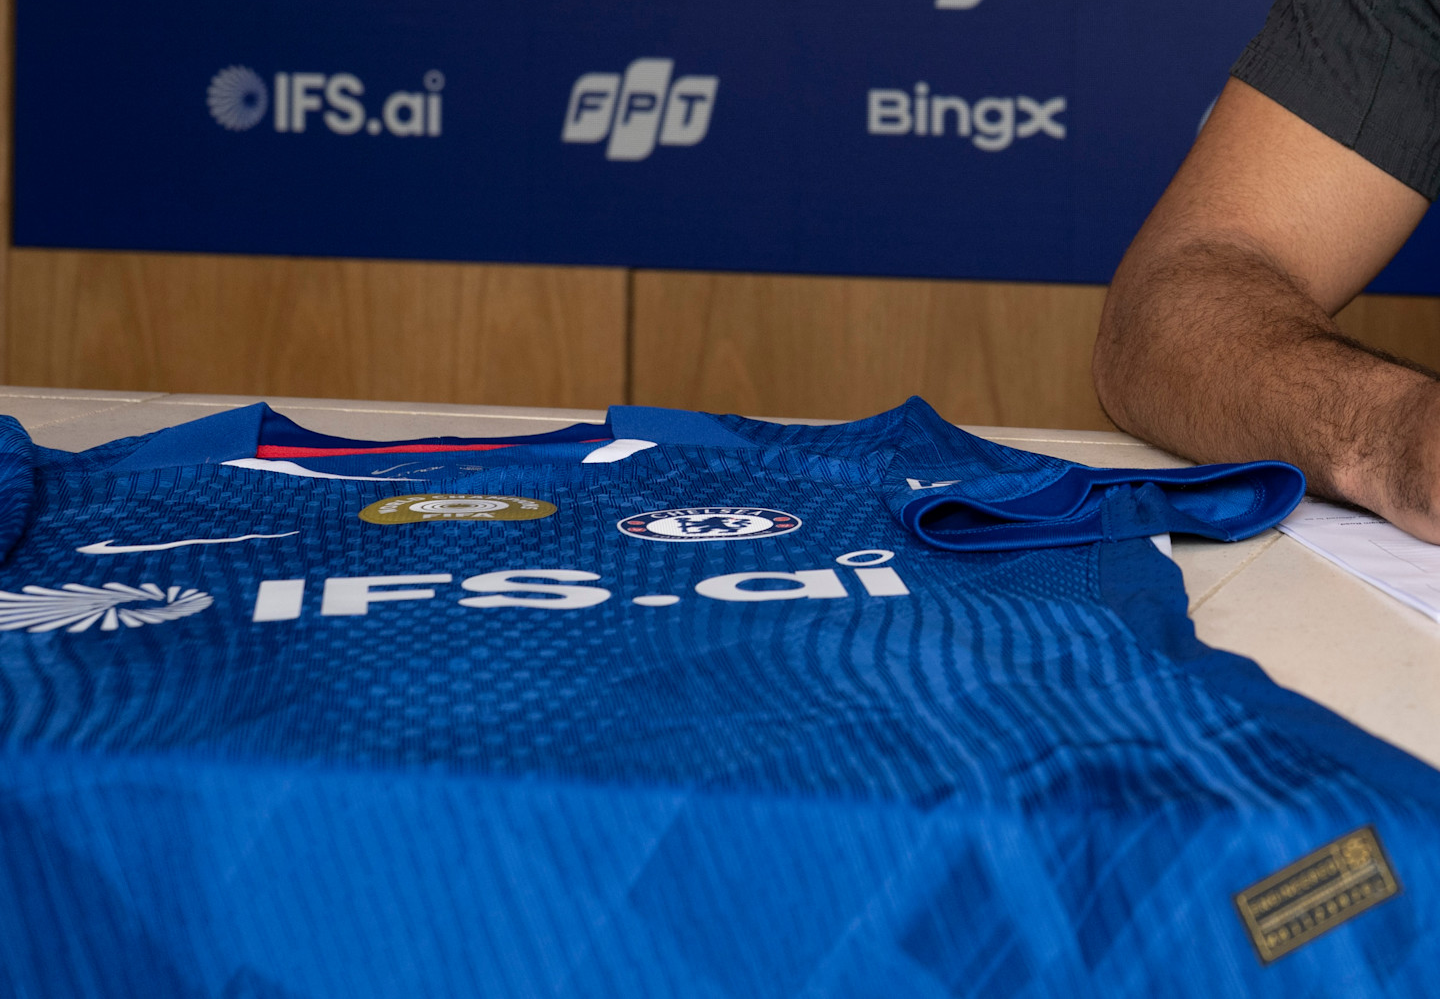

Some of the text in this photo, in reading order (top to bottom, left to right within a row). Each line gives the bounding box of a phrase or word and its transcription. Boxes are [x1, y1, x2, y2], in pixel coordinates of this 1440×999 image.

[275, 71, 444, 136] IFS.ai
[651, 509, 762, 518] CHELSEA
[252, 549, 910, 623] IFS.ai
